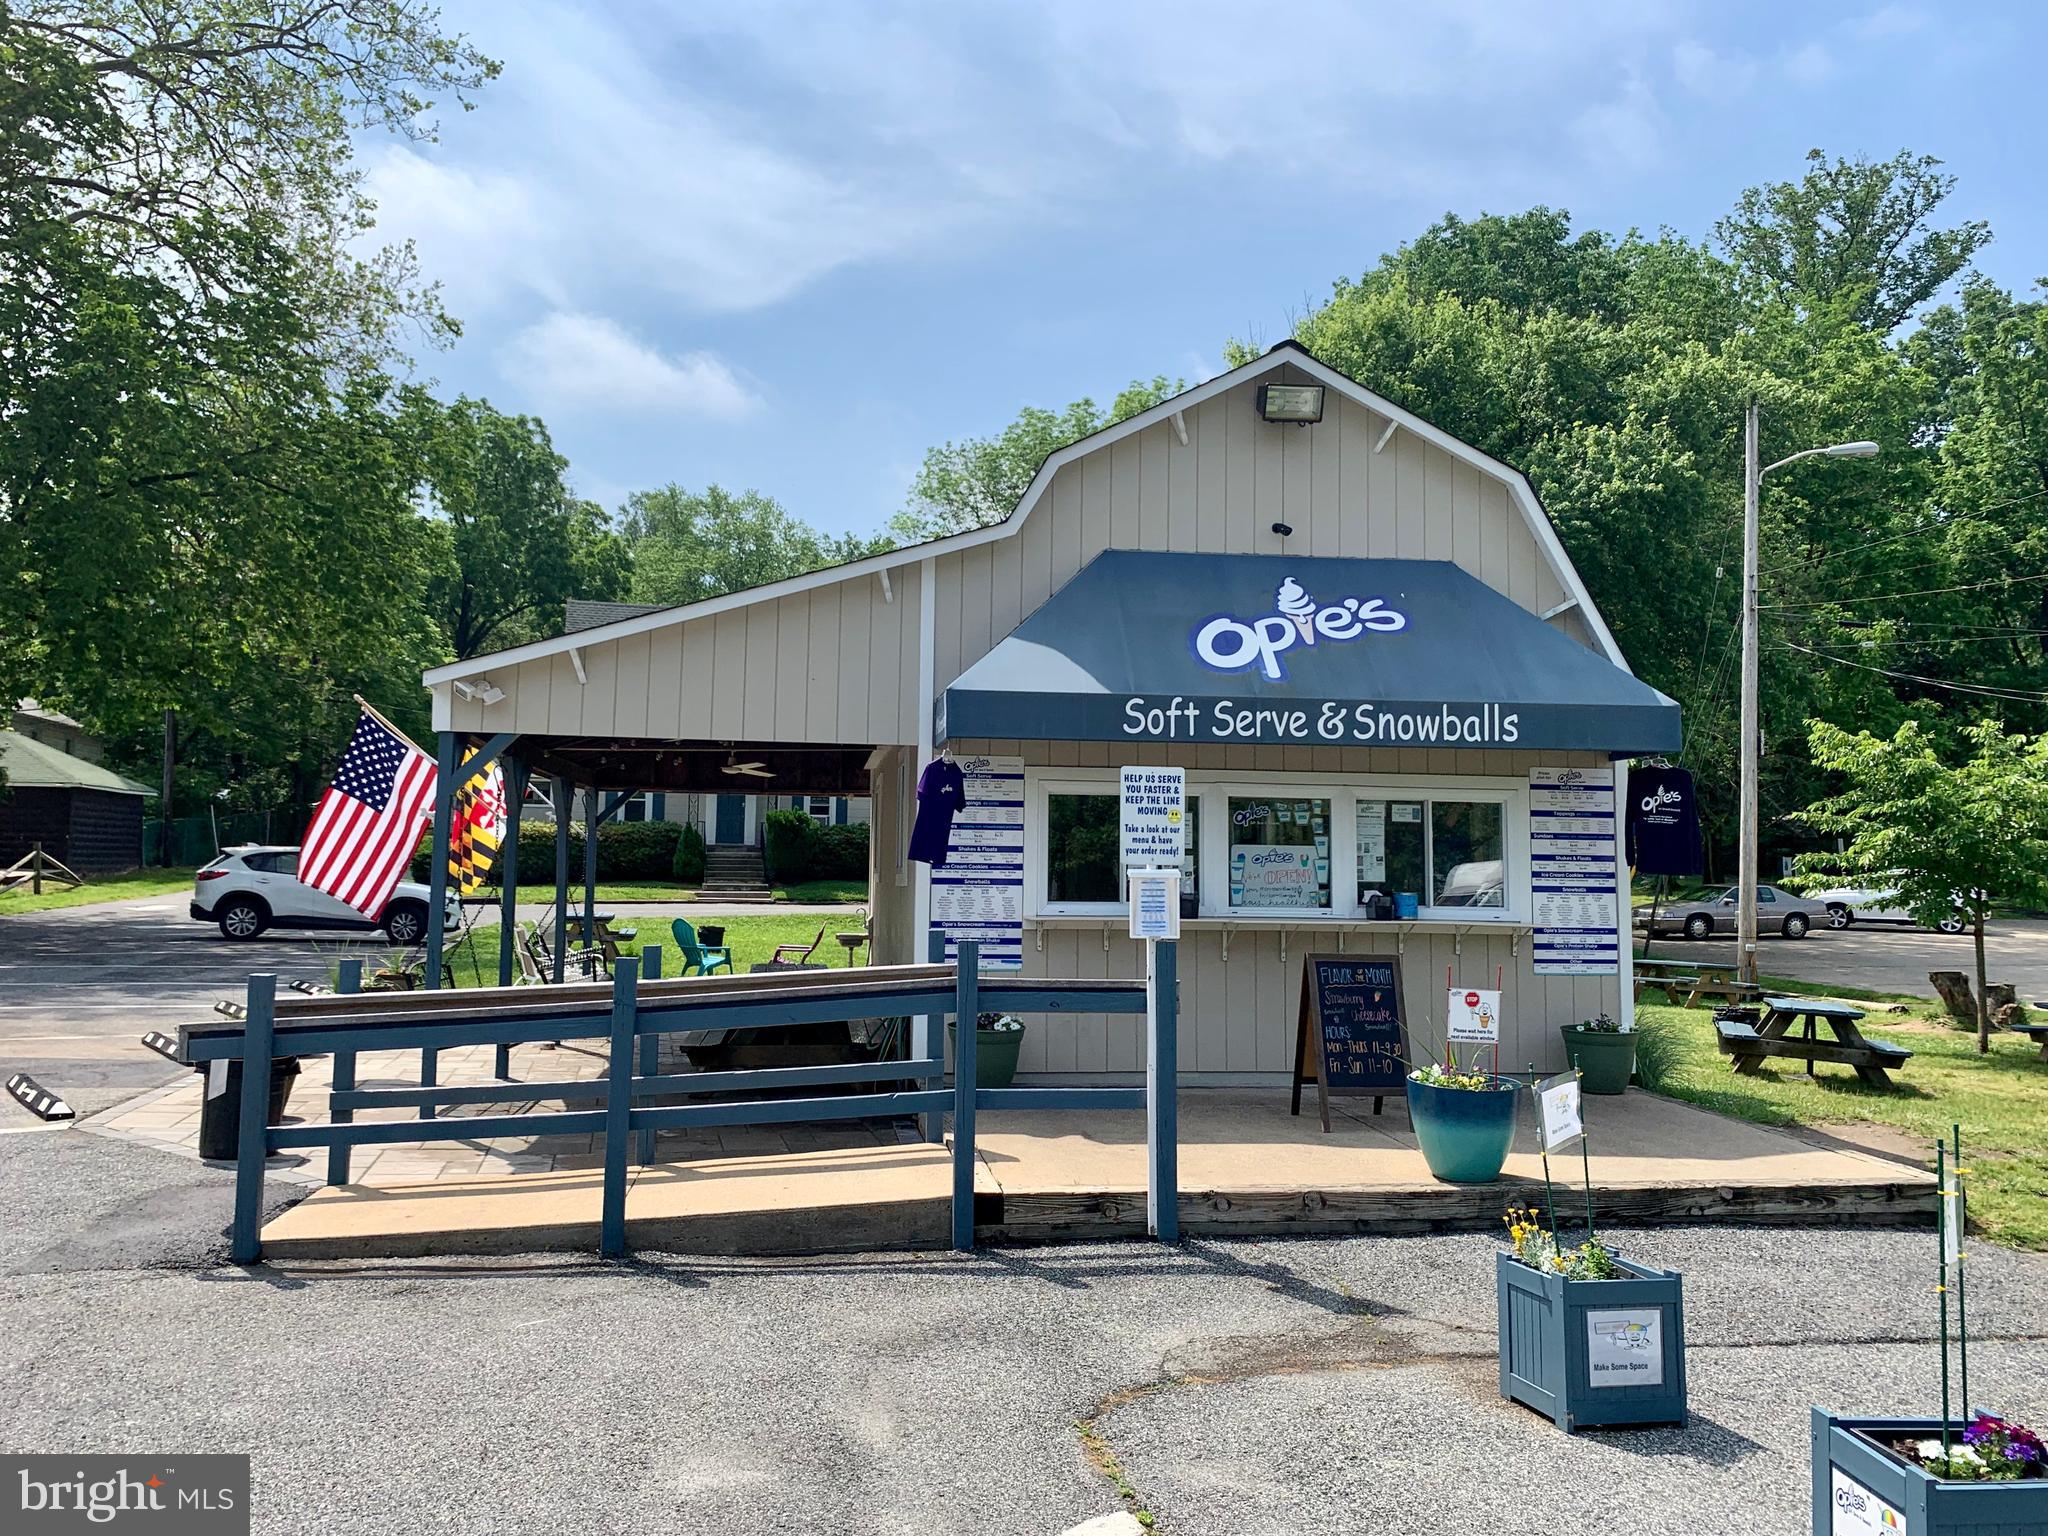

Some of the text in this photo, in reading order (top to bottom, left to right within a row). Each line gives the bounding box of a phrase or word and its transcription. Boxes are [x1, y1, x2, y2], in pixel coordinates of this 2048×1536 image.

[1196, 576, 1406, 678] Opie's
[1122, 697, 1519, 743] Soft Serve & Snowballs
[1124, 774, 1182, 784] HELP US SERVE
[1126, 785, 1180, 794] YOU FASTER &
[1125, 795, 1180, 805] KEEP THE LINE
[1641, 784, 1682, 814] Opie's
[1137, 807, 1168, 815] MOVING
[1124, 824, 1139, 833] Take
[1147, 824, 1159, 833] look
[1162, 825, 1168, 833] at
[1151, 836, 1157, 844] &
[1158, 836, 1173, 844] have
[1125, 846, 1179, 857] your order ready!
[1320, 966, 1354, 984] FLAVOR
[1365, 967, 1392, 984] MONTH
[1351, 1007, 1392, 1021] Cheesecake
[1593, 1362, 1649, 1372] Make Some Space
